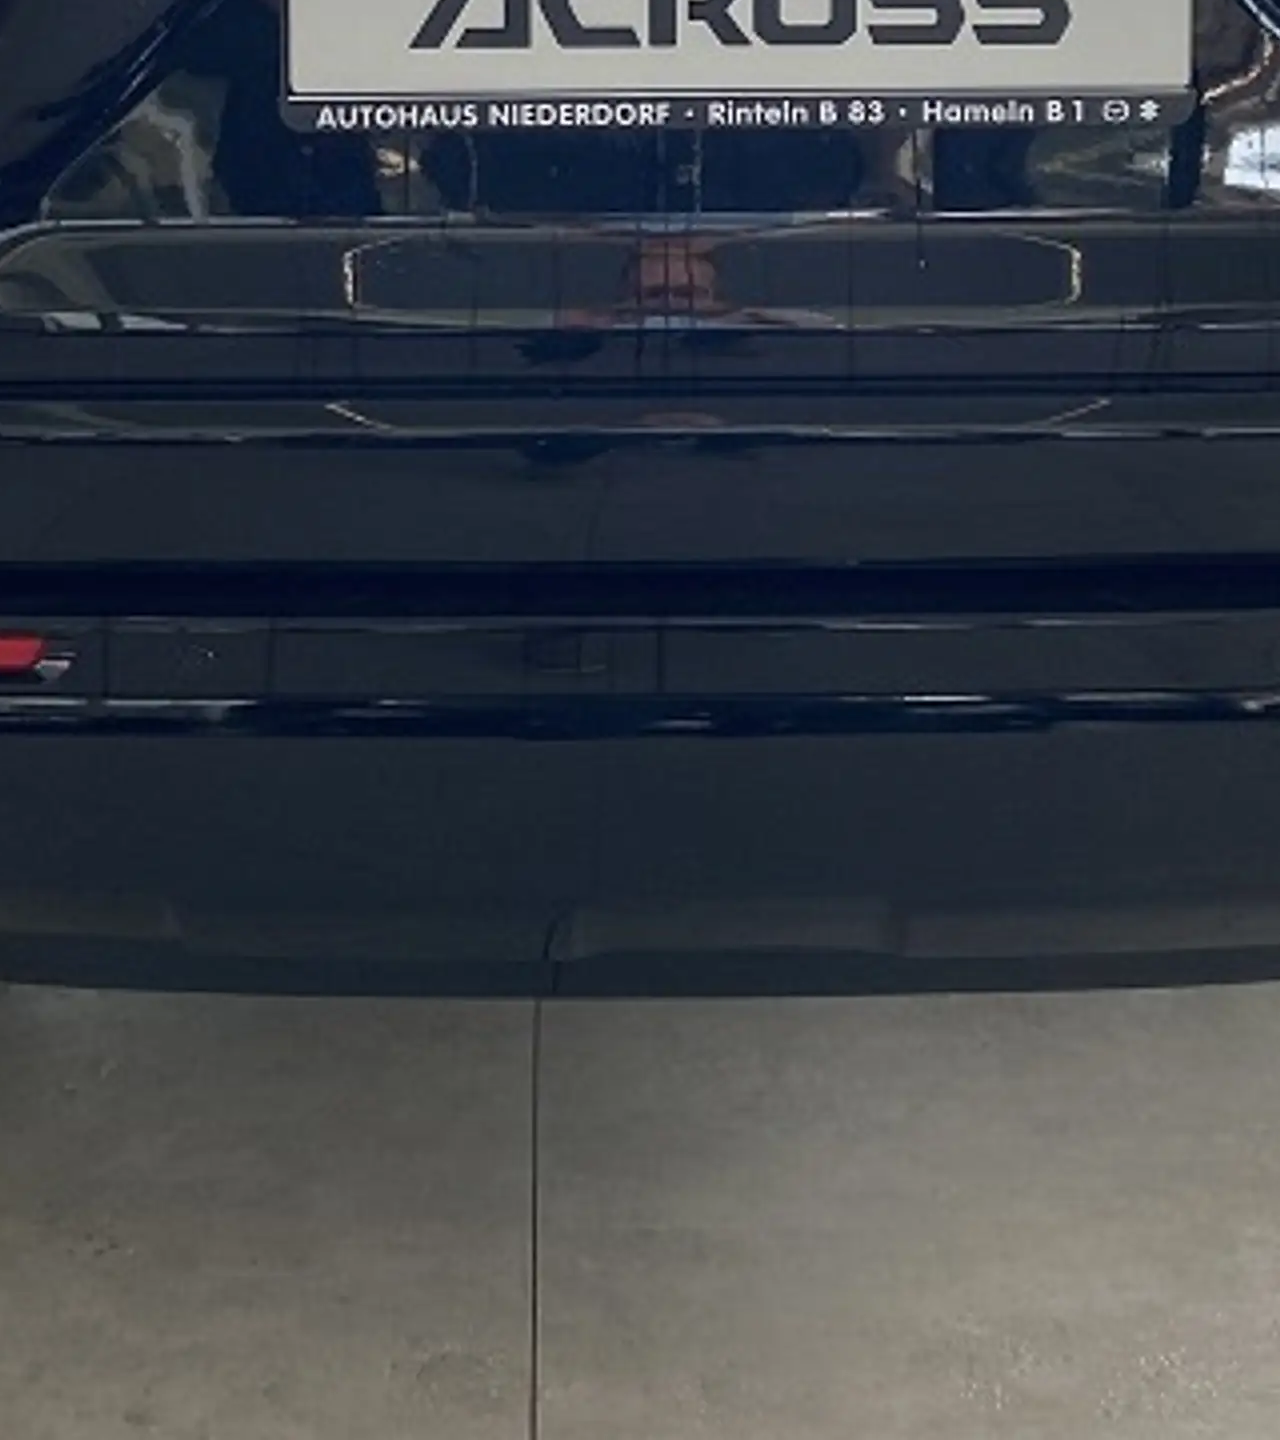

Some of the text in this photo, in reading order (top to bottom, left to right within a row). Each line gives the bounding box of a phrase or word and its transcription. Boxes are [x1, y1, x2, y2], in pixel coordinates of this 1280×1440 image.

[316, 103, 479, 130] AUTOHAUS
[488, 101, 672, 127] NIEDERDORF
[708, 100, 810, 126] Rinteln
[819, 100, 838, 125] B
[847, 99, 886, 125] 83
[922, 98, 1035, 125] Hameln
